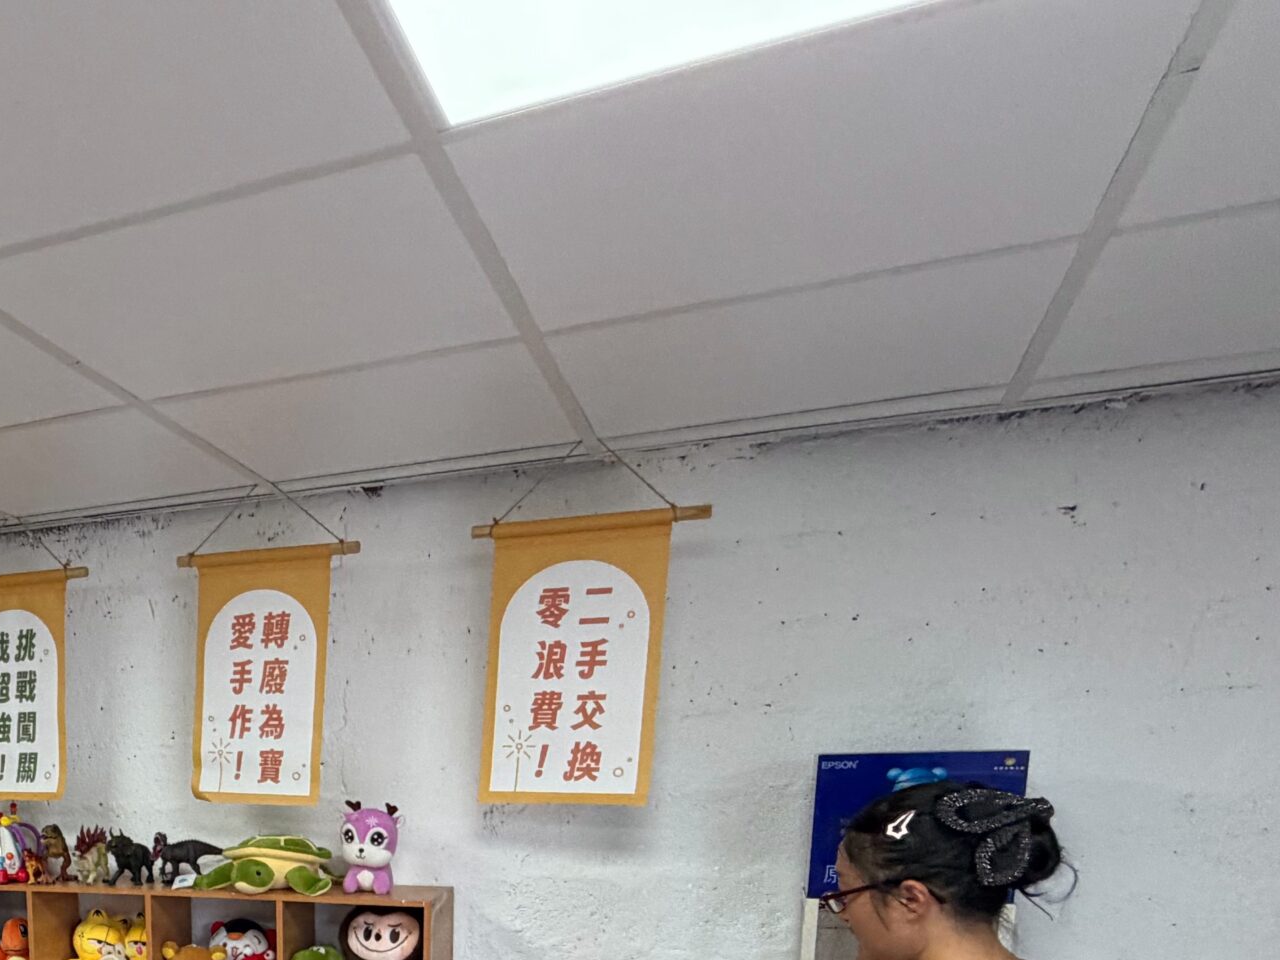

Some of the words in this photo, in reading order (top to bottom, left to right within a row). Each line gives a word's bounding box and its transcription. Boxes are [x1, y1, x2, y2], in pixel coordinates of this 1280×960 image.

[15, 628, 38, 783] 挑戰闖關
[228, 612, 257, 781] 愛手作！
[258, 611, 291, 784] 轉廢為寶
[528, 586, 570, 778] 零浪費！
[563, 587, 614, 783] 二手交換
[821, 760, 858, 770] EPSON
